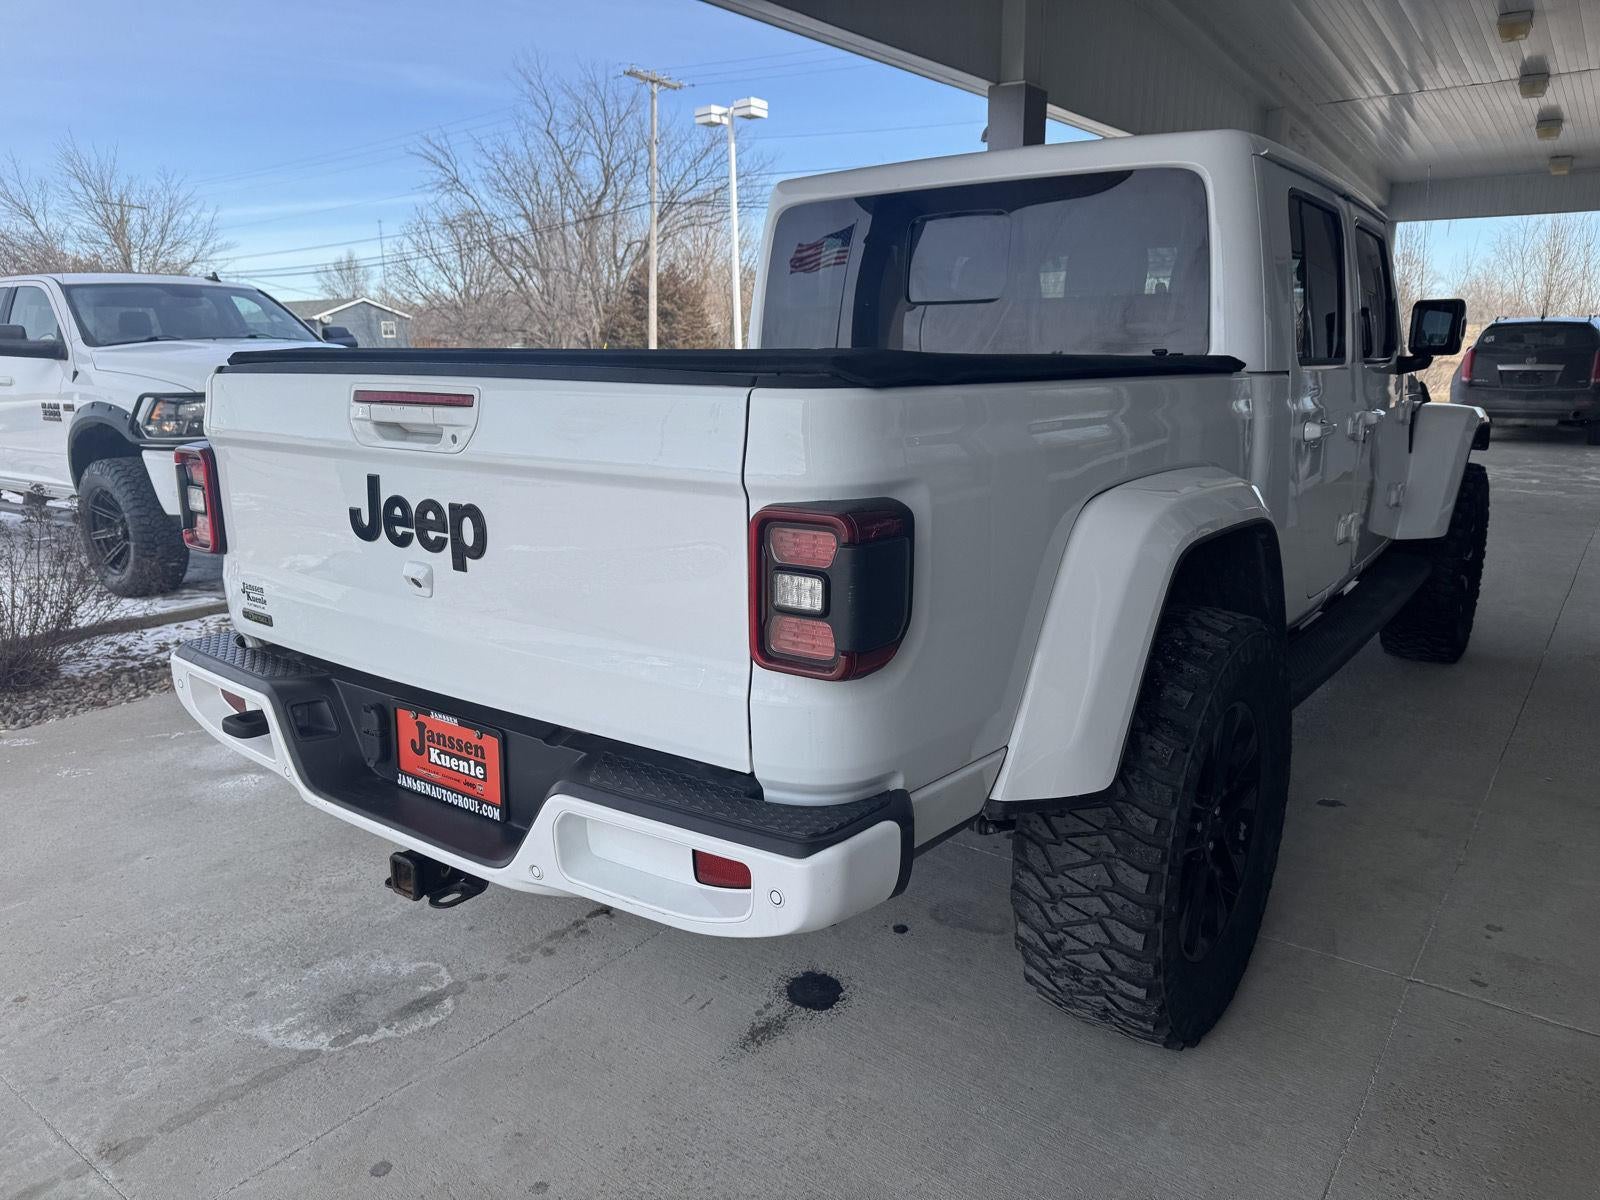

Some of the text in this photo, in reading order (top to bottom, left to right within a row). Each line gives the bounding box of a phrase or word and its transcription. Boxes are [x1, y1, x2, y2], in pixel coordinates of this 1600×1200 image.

[348, 473, 487, 572] Jeep
[430, 711, 458, 725] JANSSEN
[411, 721, 486, 760] Janssen
[429, 747, 485, 779] Kuenle
[397, 773, 501, 821] JANSSENAUTOGROUP.COM
[463, 779, 477, 790] Jeep
